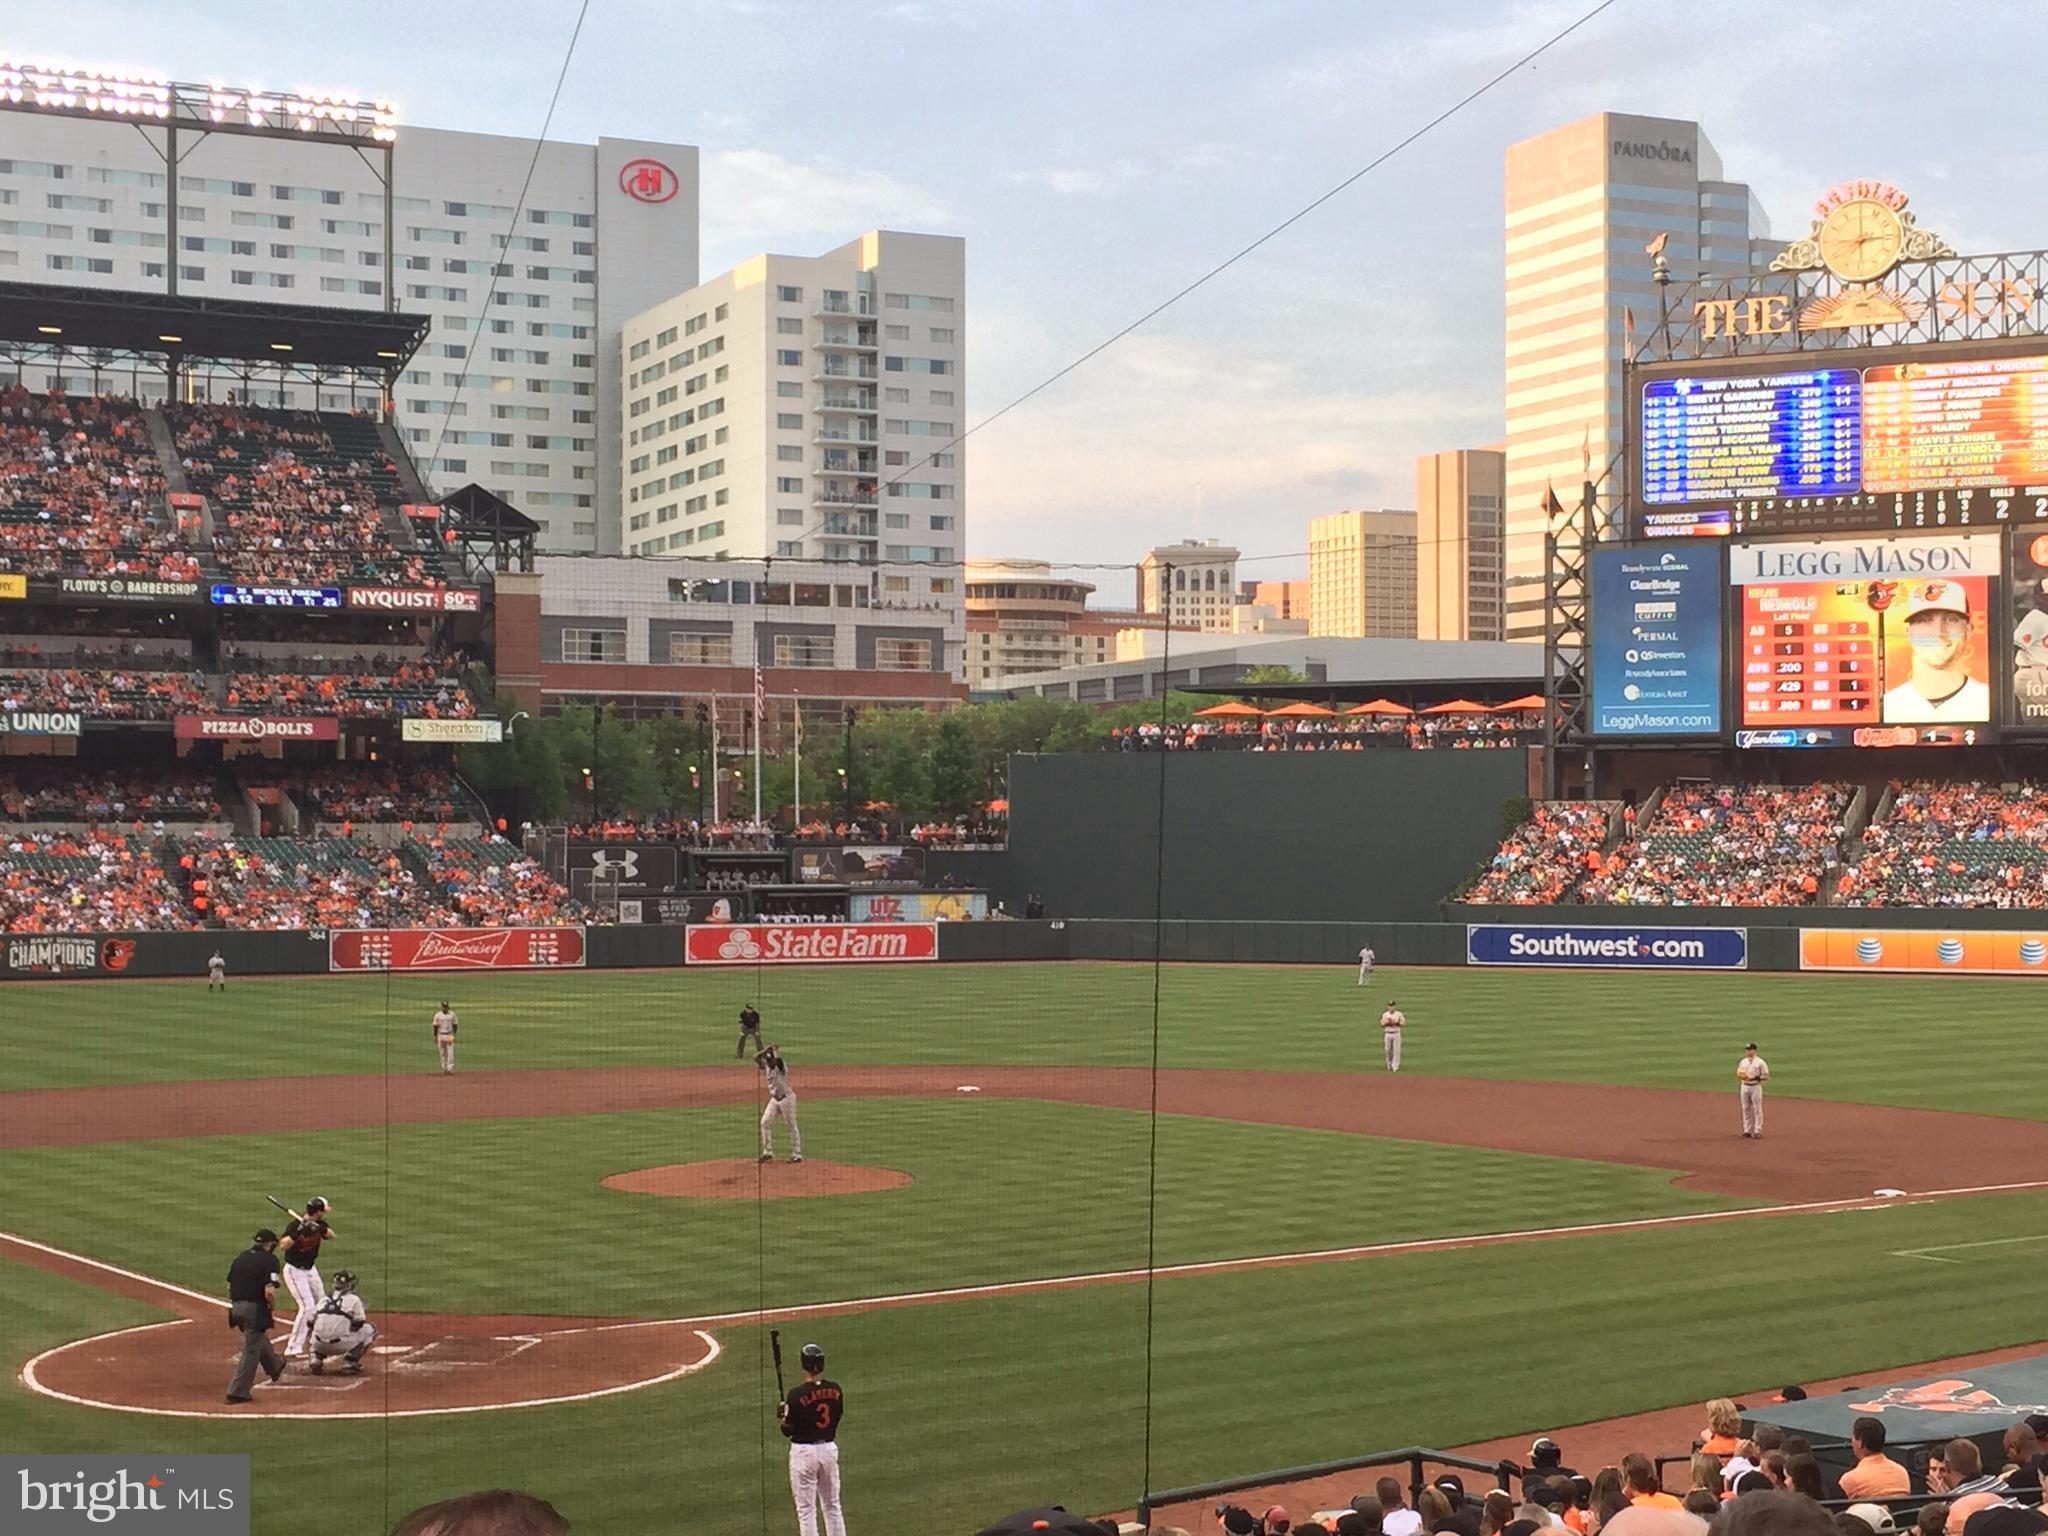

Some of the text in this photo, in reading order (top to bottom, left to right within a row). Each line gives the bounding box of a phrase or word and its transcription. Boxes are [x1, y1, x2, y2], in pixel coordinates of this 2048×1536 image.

[1694, 278, 2034, 338] THE SUN
[1702, 375, 1814, 391] NEW YORK YANKEES
[1687, 447, 1729, 457] CARLOS
[1731, 444, 1781, 455] BELTRAN
[1710, 455, 1774, 467] GREGORIUS
[1687, 468, 1735, 479] STEPHEN
[1990, 487, 2015, 497] BALLS
[1645, 513, 1699, 524] YANKEES
[1996, 500, 2009, 519] 2
[2035, 498, 2048, 517] 2
[1646, 526, 1695, 536] ORIOLES
[1755, 546, 1972, 578] LEGG MASON
[63, 579, 198, 595] FLOYD'S BARBERSHOP
[238, 595, 253, 604] 12
[352, 591, 434, 608] NYQUIST
[444, 592, 464, 604] 60
[1638, 632, 1679, 641] PERMAL
[1785, 625, 1793, 635] 5
[1777, 662, 1802, 673] .200
[13, 713, 80, 731] UNION
[202, 721, 314, 735] PIZZA BOLI'S
[427, 722, 483, 733] Sheraton
[1602, 714, 1711, 730] LeggMason.com
[308, 931, 326, 941] 364
[420, 939, 502, 956] Budweiser
[9, 943, 96, 968] CHAMPIONS
[816, 1403, 830, 1429] 3
